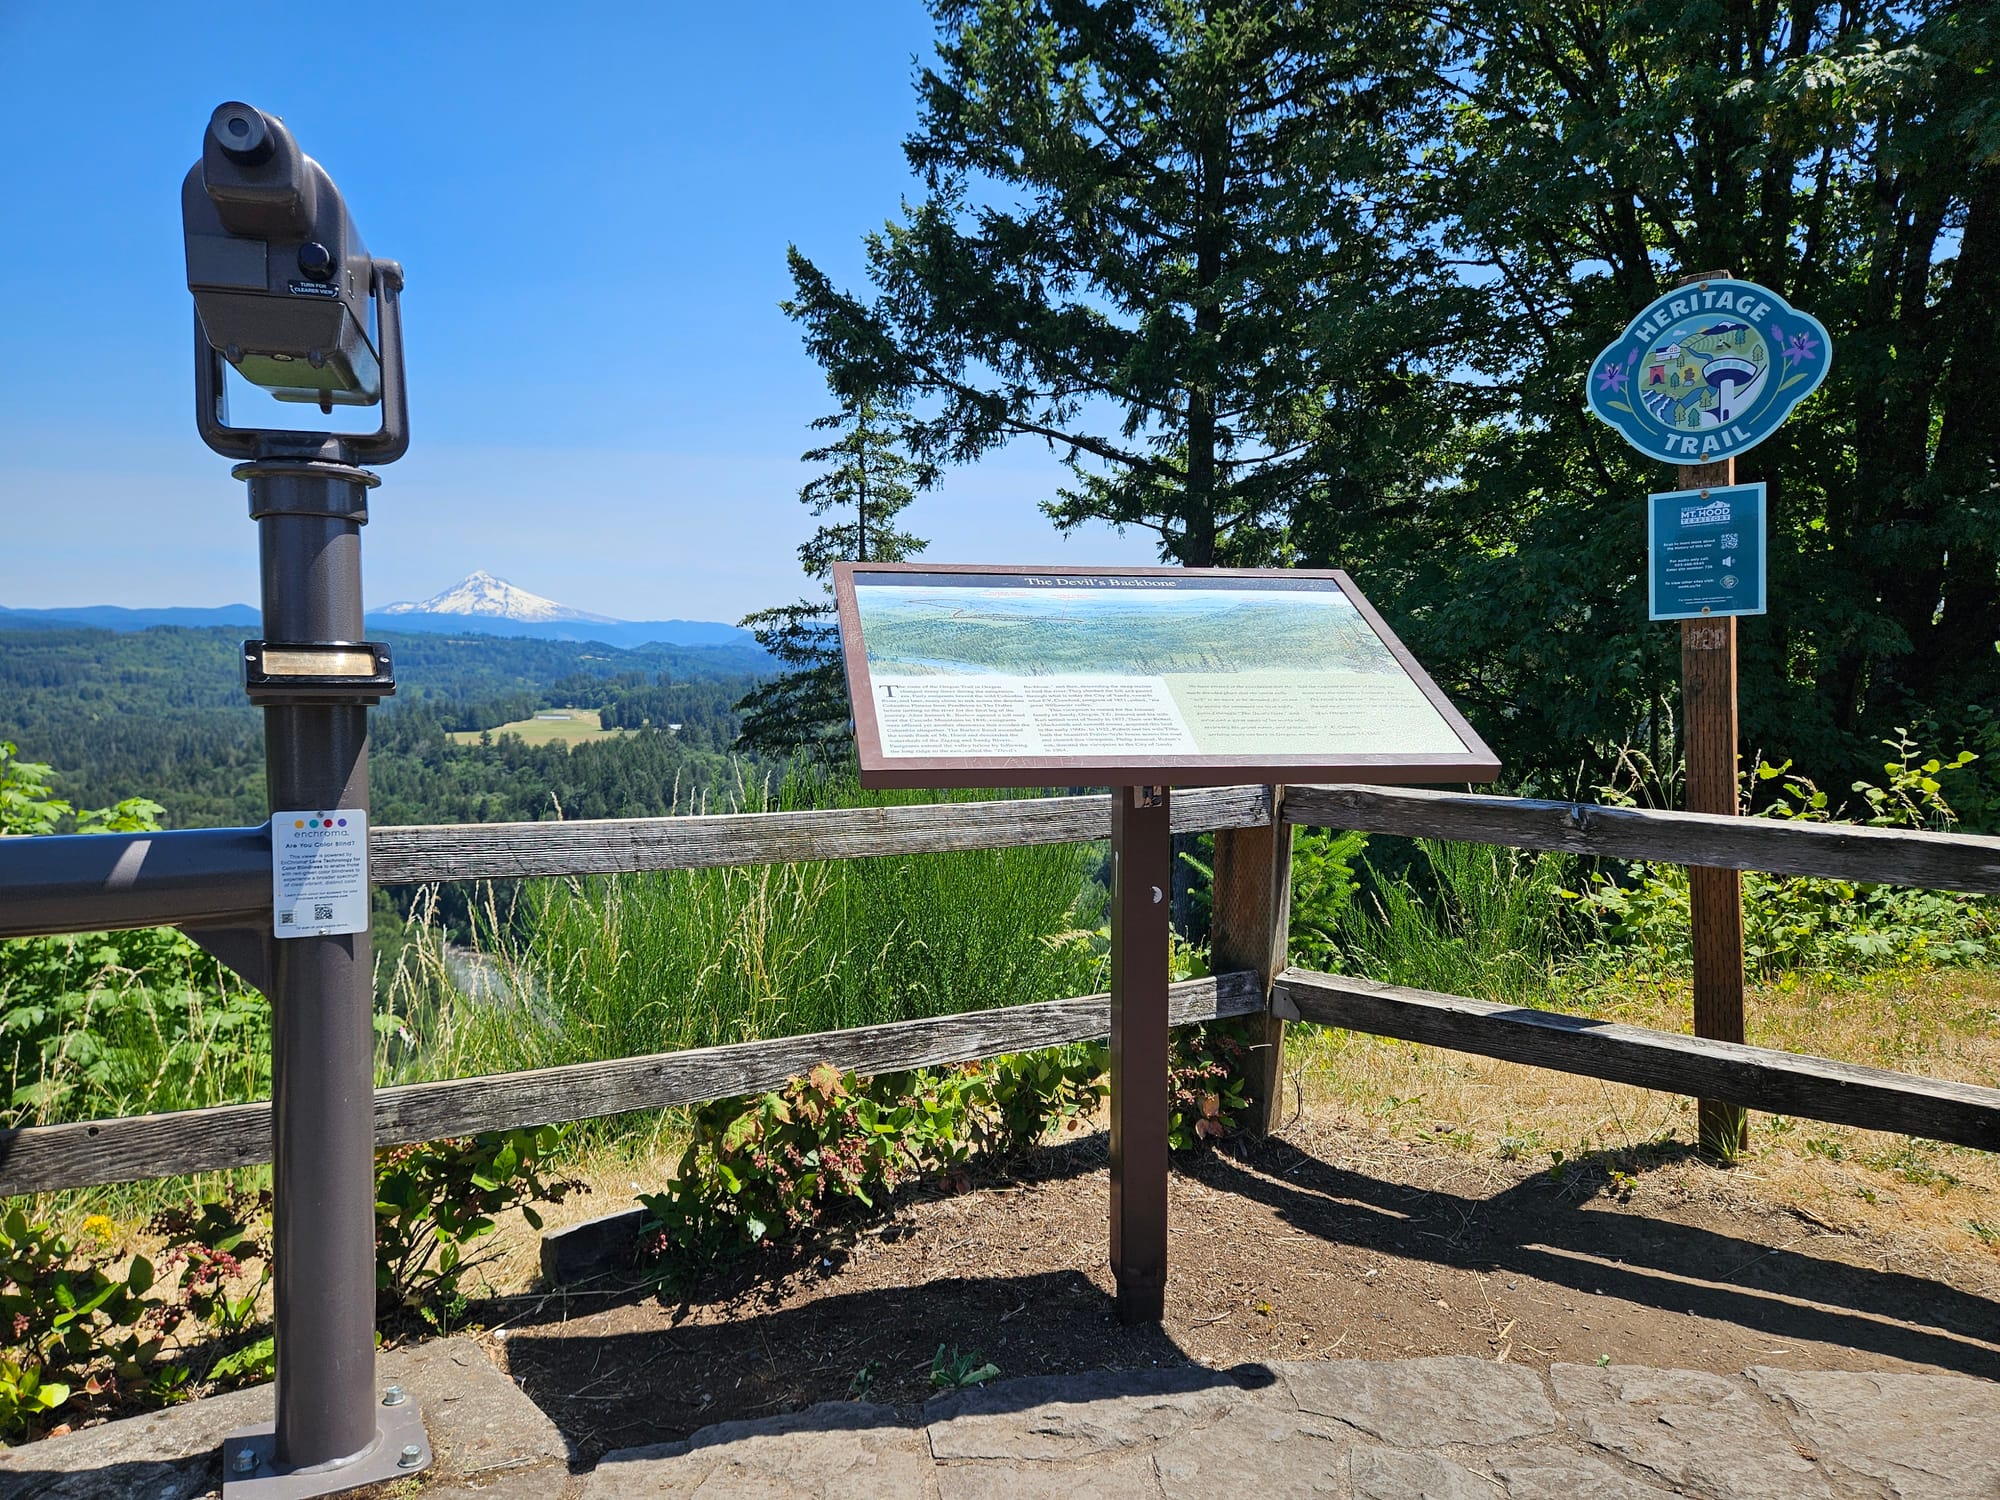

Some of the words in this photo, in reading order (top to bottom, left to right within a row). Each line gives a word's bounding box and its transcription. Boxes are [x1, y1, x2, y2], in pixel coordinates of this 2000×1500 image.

[1635, 290, 1771, 343] HERITAGE
[1664, 424, 1752, 454] TRAIL
[1699, 508, 1730, 517] HOOD
[1682, 515, 1730, 524] TERRITORY
[1024, 577, 1052, 586] The
[1056, 578, 1106, 586] Devil's
[1110, 579, 1176, 587] Backbone
